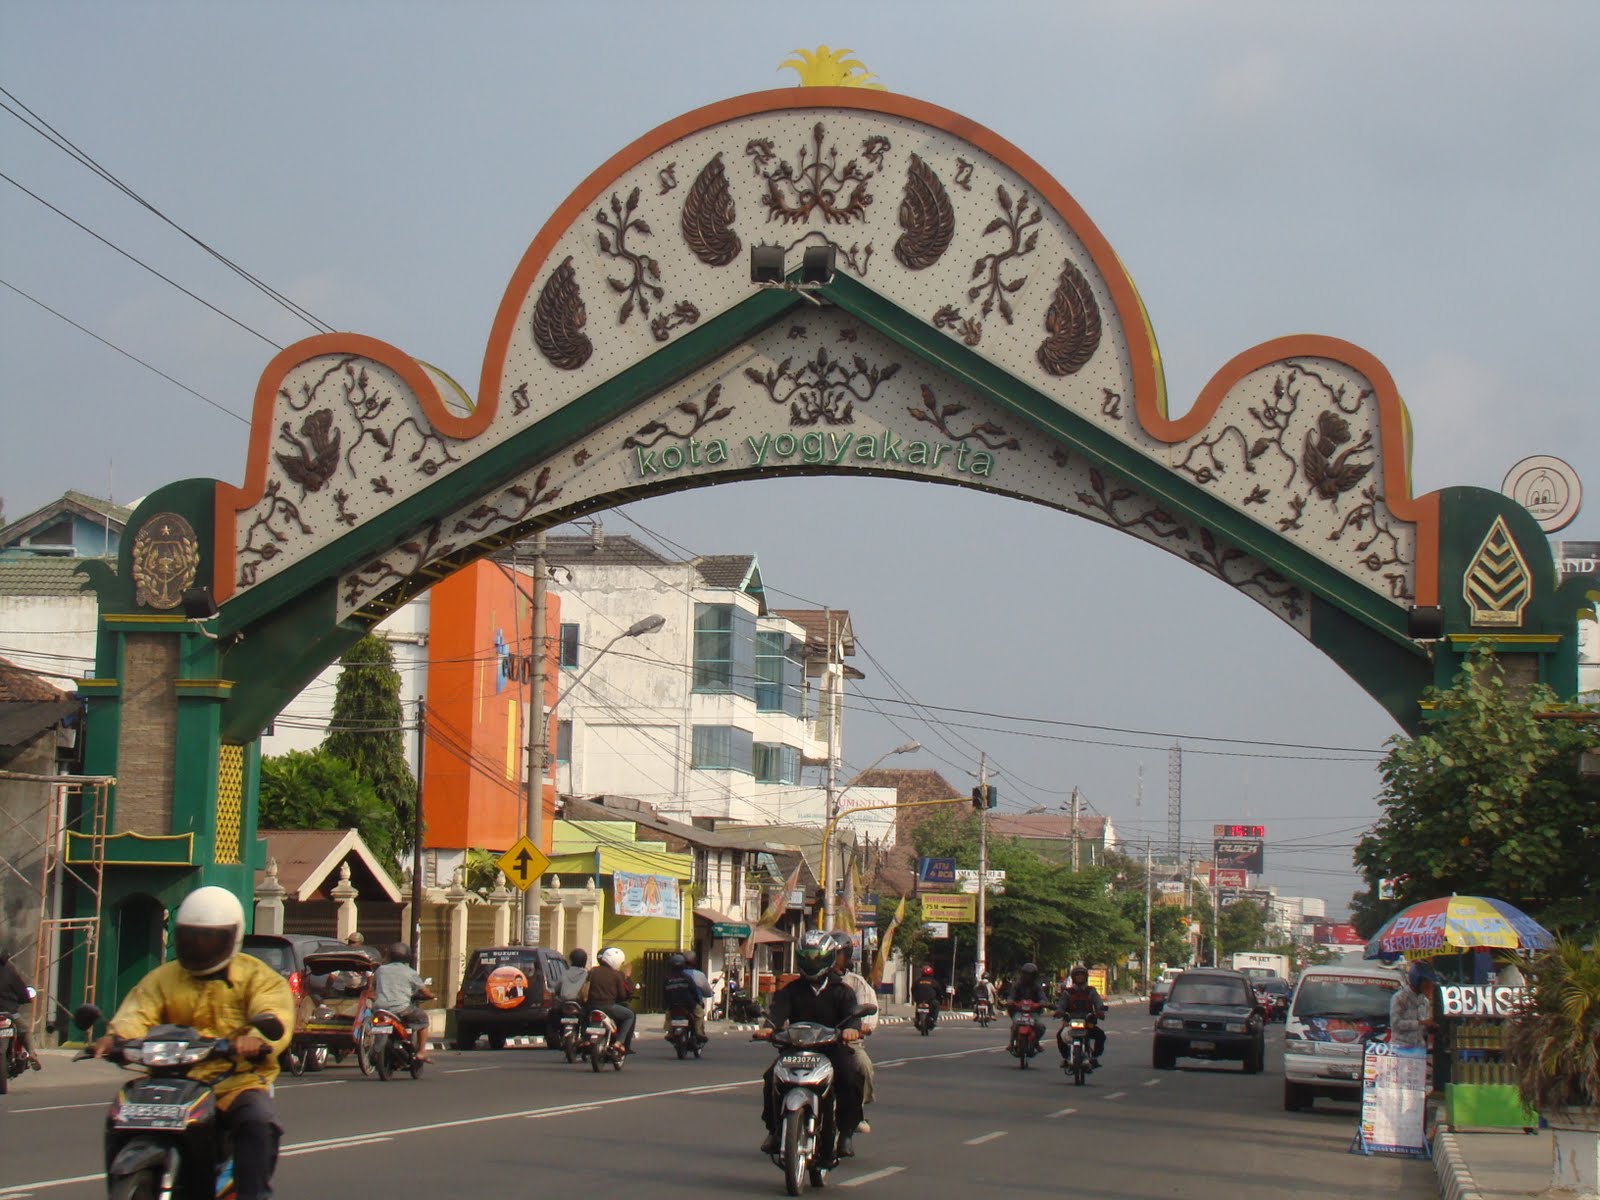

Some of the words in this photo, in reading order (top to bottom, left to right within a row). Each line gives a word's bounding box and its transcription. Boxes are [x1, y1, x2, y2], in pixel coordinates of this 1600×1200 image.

[637, 436, 728, 477] kota
[747, 429, 995, 477] yogyakarta
[1231, 825, 1265, 838] 15:17
[1391, 912, 1446, 935] PULSA
[1382, 936, 1416, 951] SERBA
[1418, 935, 1444, 950] BISA
[1368, 980, 1399, 988] MOTOR
